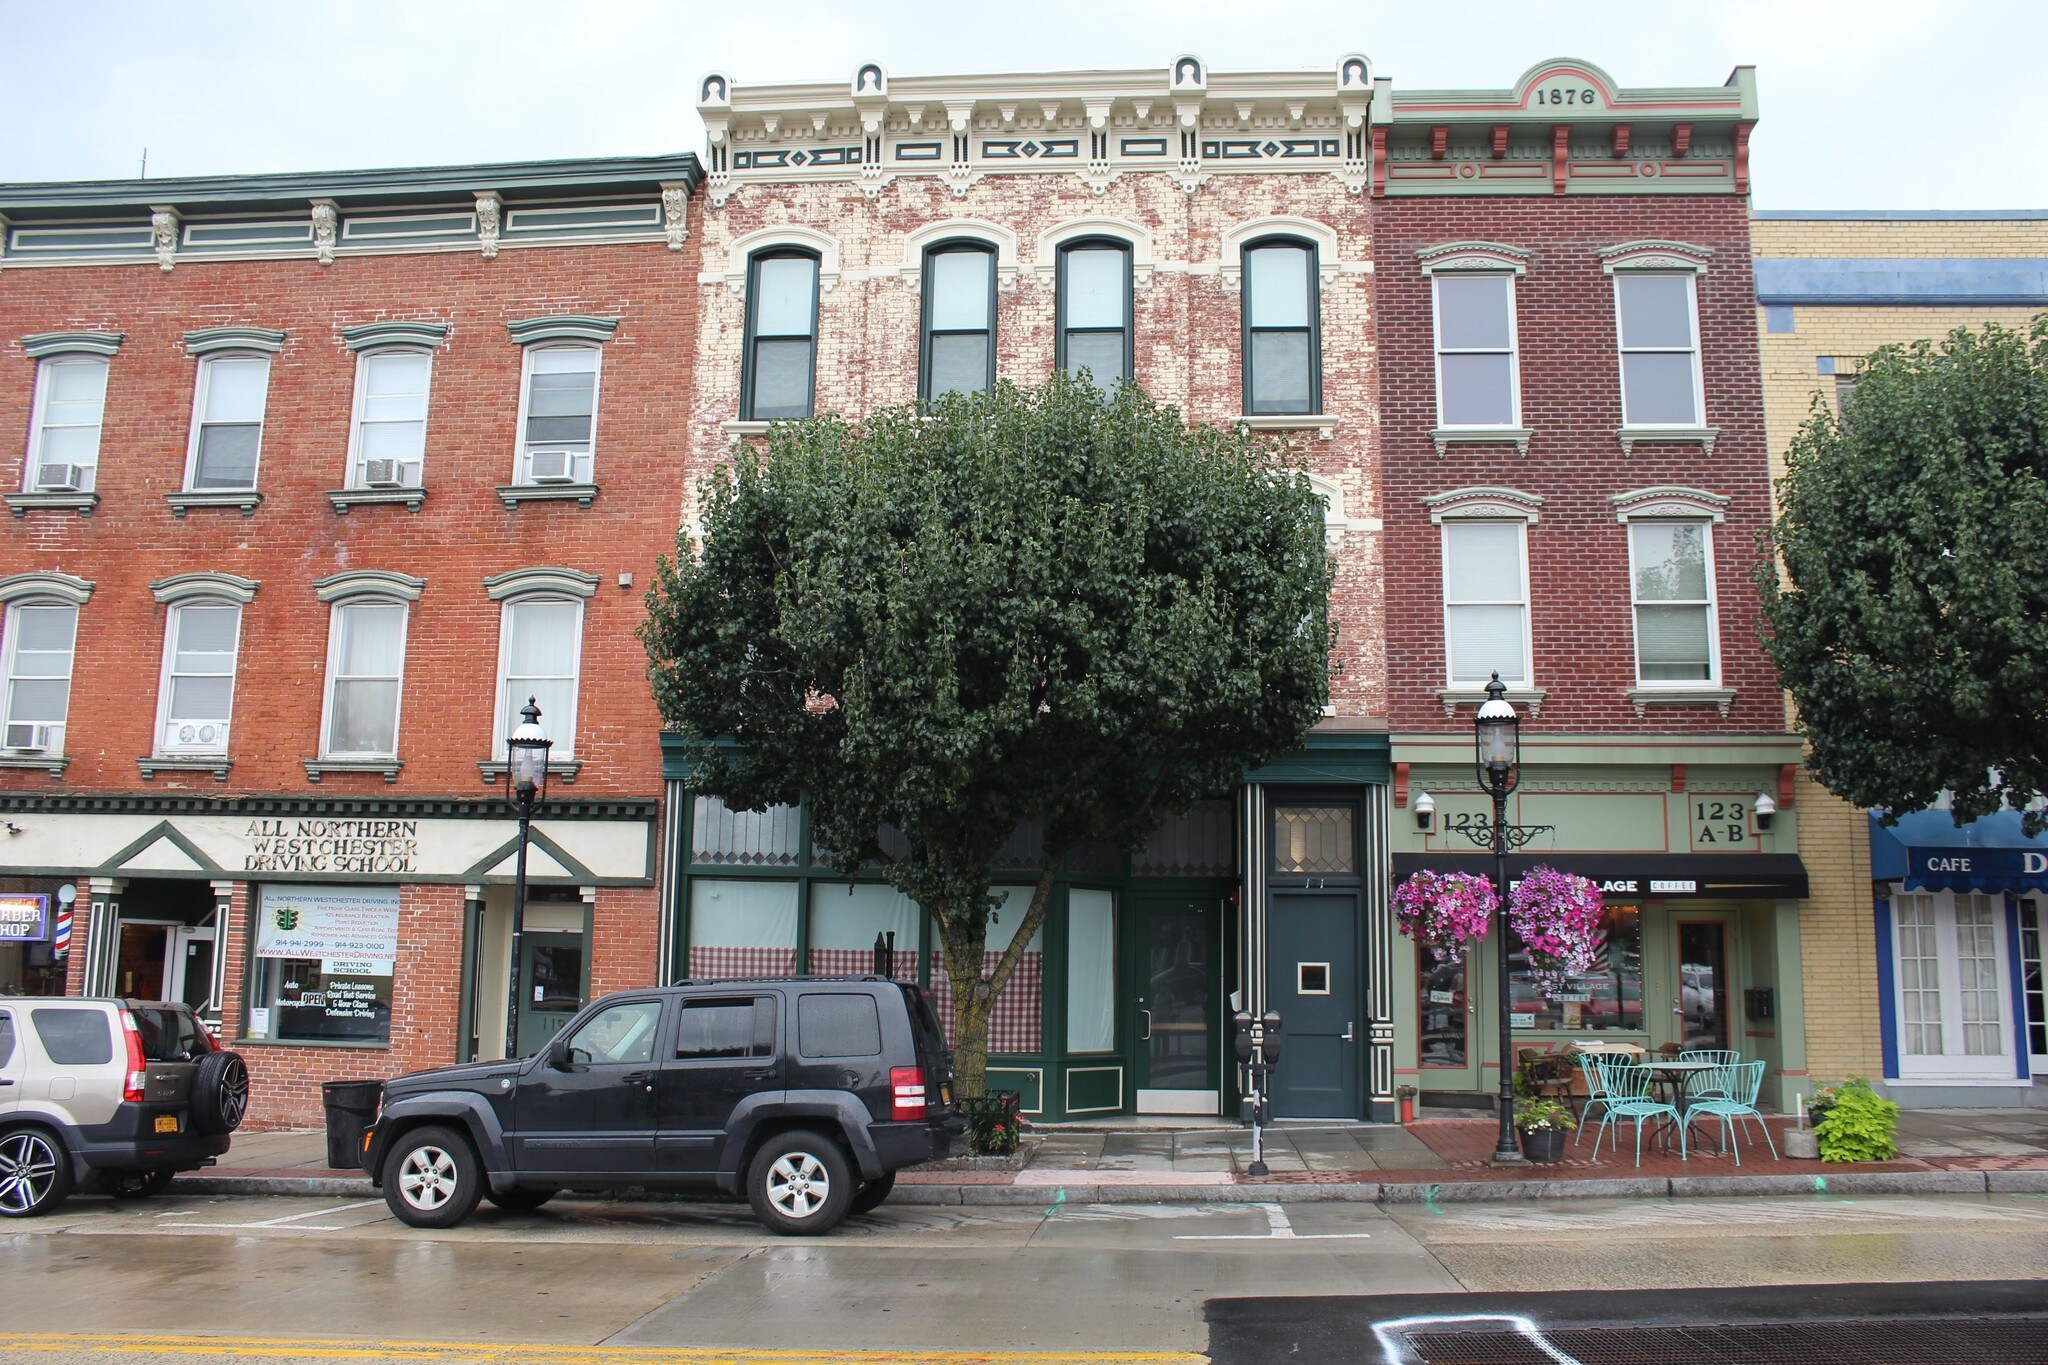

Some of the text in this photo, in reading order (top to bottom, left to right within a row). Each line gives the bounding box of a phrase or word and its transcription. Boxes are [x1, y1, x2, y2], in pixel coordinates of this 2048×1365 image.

[1537, 88, 1596, 105] 1876
[1697, 802, 1744, 820] 123
[1443, 812, 1488, 830] 123
[245, 819, 418, 838] ALL NORTHERN
[252, 837, 418, 856] WESTCHESTER
[244, 854, 418, 873] DRIVING SCHOOL
[1927, 857, 1971, 872] CAFE
[2022, 852, 2048, 874] D
[1592, 880, 1638, 892] LAGE
[1652, 881, 1695, 890] COFFEE
[277, 895, 313, 903] NORTHERN
[313, 896, 361, 904] WESTCHESTER
[260, 948, 396, 960] WWW.ALLWESTCHESTERDRIVING.NE
[284, 980, 299, 989] Auto
[329, 981, 375, 991] Private Lessons
[303, 993, 326, 1004] OPEN
[326, 990, 376, 1000] Road Test Service
[352, 1000, 368, 1008] Class
[325, 1008, 375, 1019] Defensive Driving
